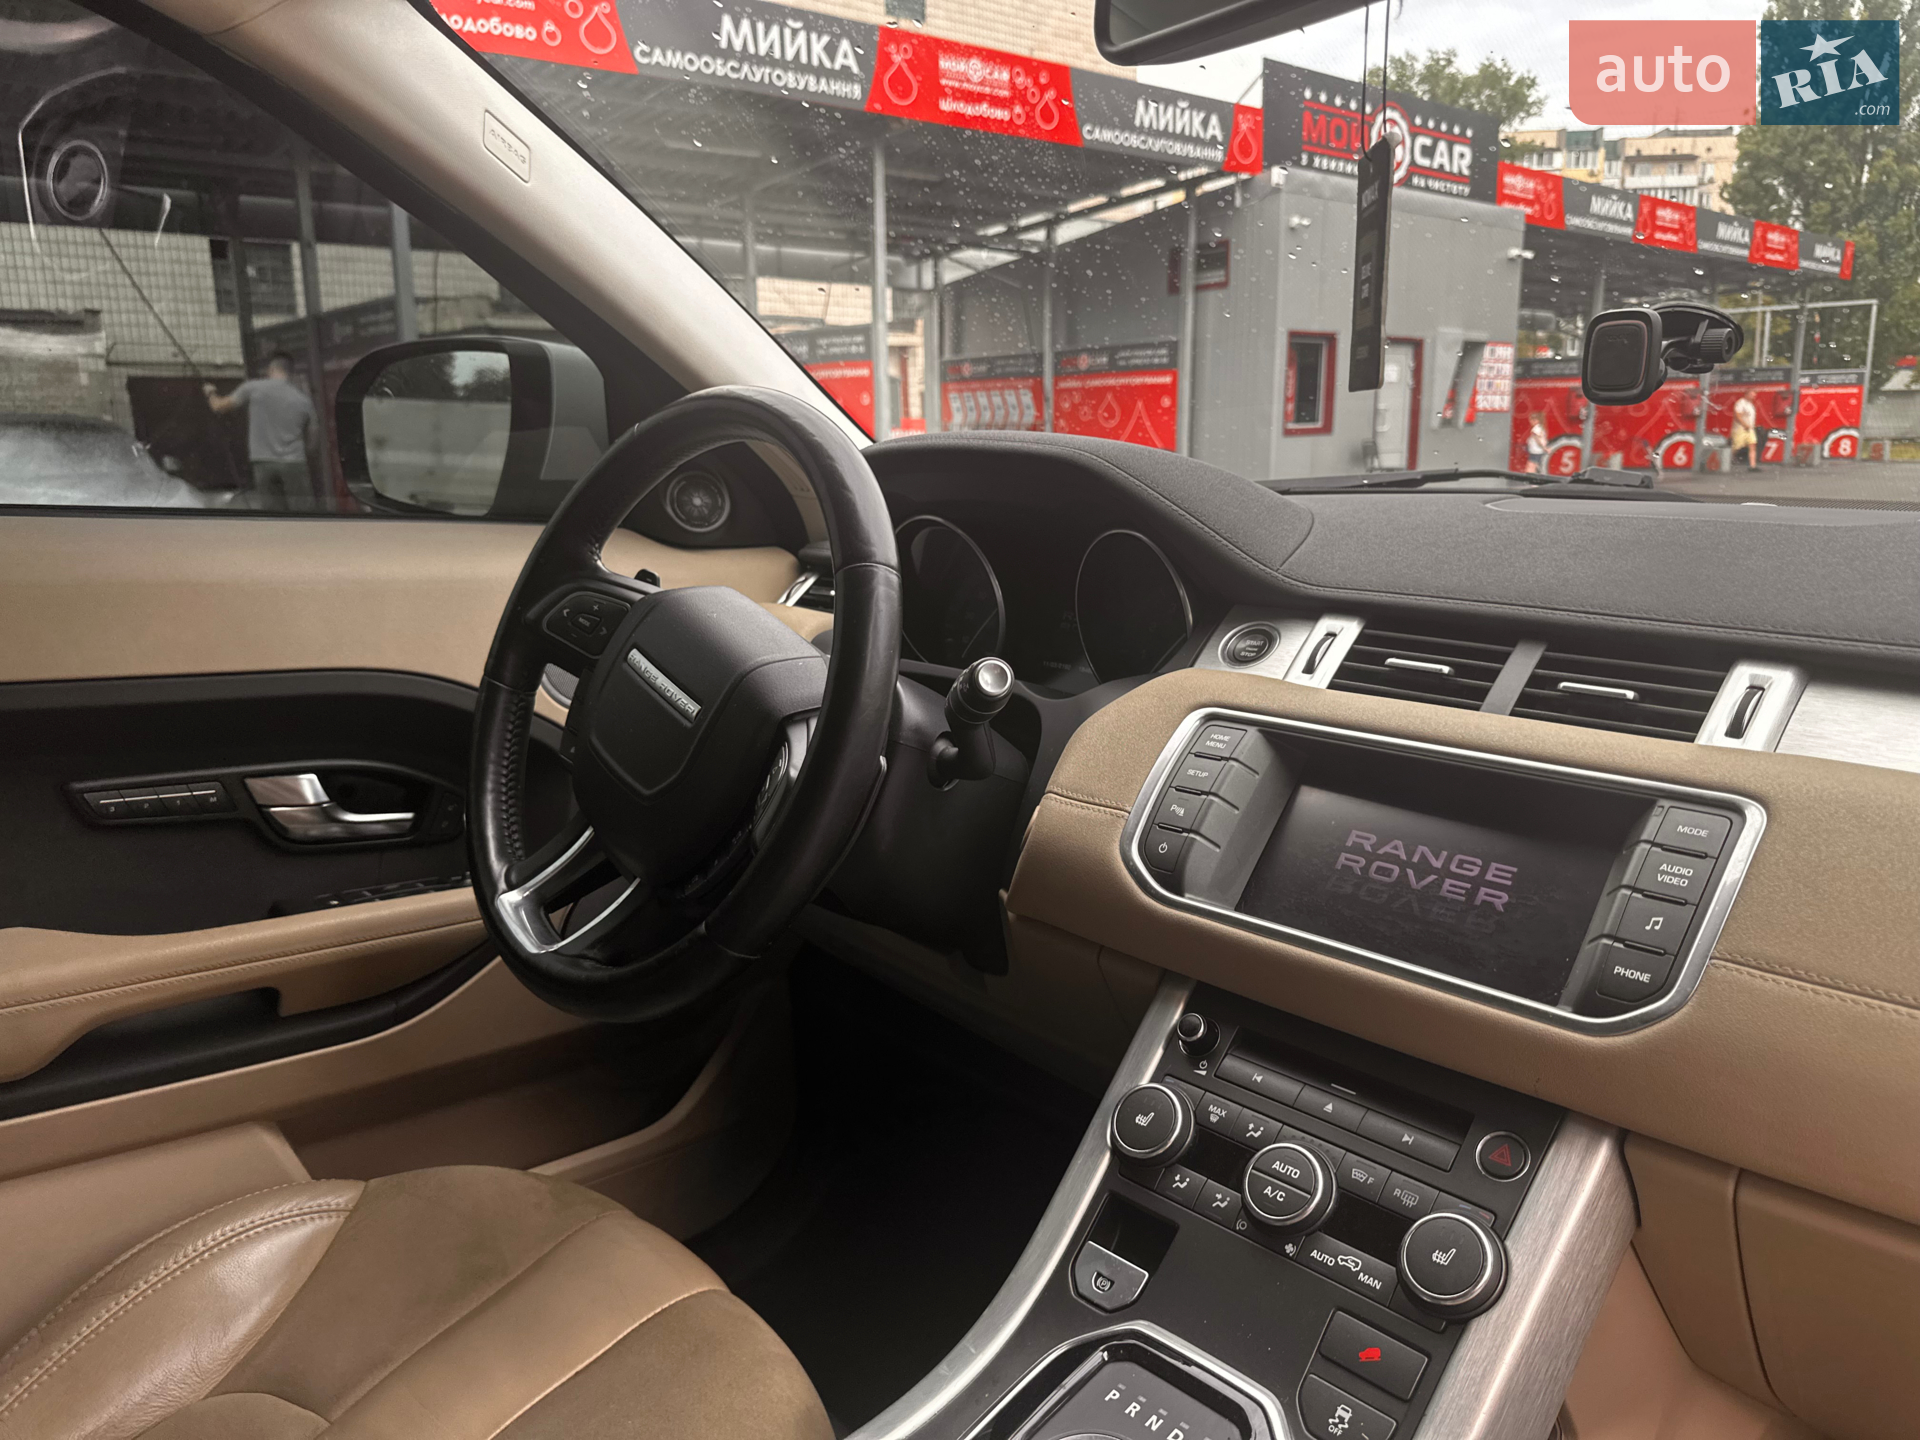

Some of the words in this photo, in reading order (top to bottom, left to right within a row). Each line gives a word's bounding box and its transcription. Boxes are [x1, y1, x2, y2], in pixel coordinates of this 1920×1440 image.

[719, 13, 860, 74] МИЙКА
[633, 45, 862, 101] САМООБСЛУГОВУВАННЯ
[1133, 97, 1223, 142] МИЙКА
[1414, 134, 1473, 176] CAR
[1673, 447, 1688, 466] 6
[1764, 442, 1779, 461] 7
[1838, 439, 1852, 456] 8
[1559, 451, 1576, 474] 5
[1245, 639, 1265, 647] START
[628, 654, 659, 684] RANGE
[659, 682, 696, 714] ROVER
[1205, 739, 1227, 749] MENU
[1210, 733, 1231, 743] HOME
[1187, 768, 1209, 779] SETUP
[1677, 824, 1709, 838] MODE
[1345, 830, 1518, 886] RANGE
[1659, 863, 1693, 877] AUDIO
[1334, 852, 1509, 912] ROVER
[1657, 874, 1689, 887] VIDEO
[1614, 966, 1651, 983] PHONE
[1207, 1104, 1228, 1119] MAX
[1271, 1160, 1300, 1180] AUTO
[1263, 1185, 1286, 1202] A/C
[1309, 1248, 1335, 1268] AUTO
[1357, 1272, 1382, 1290] MAN
[1104, 1389, 1121, 1402] P
[1124, 1401, 1141, 1418] R
[1144, 1414, 1164, 1432] N
[1327, 1424, 1344, 1437] OFF
